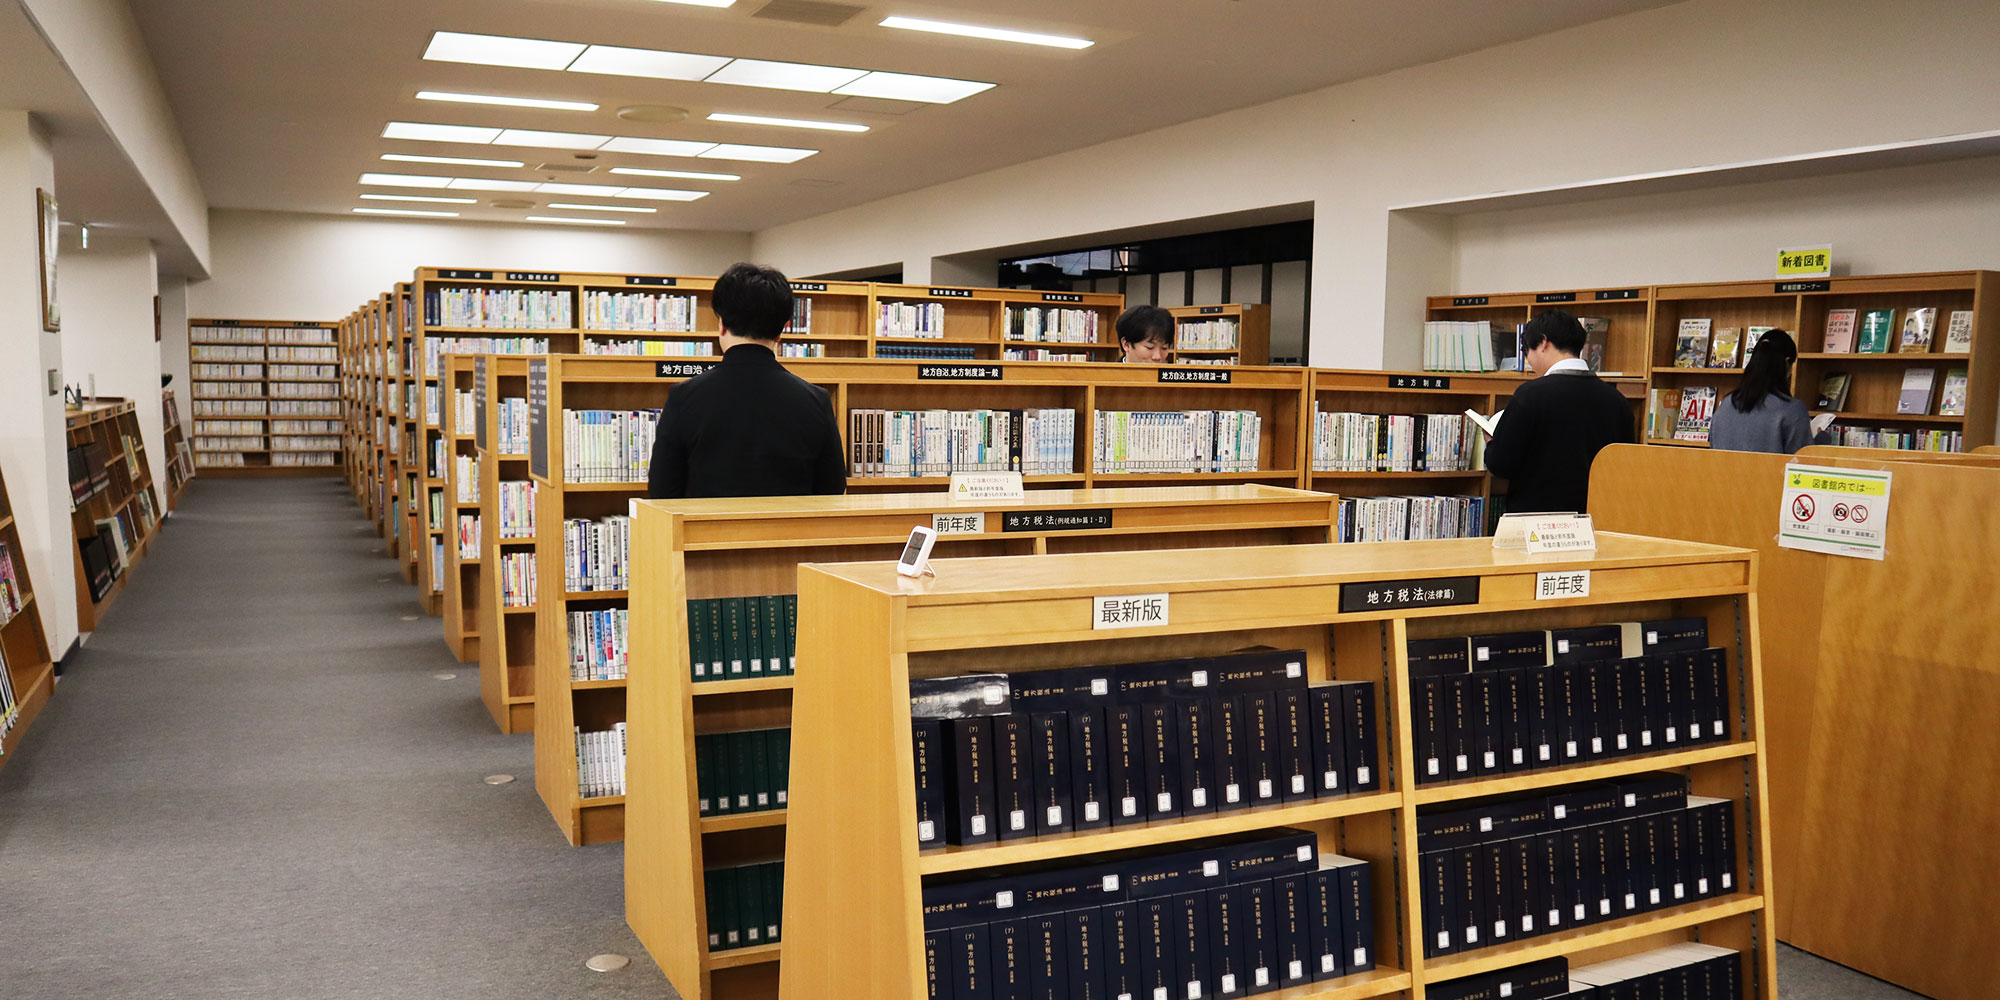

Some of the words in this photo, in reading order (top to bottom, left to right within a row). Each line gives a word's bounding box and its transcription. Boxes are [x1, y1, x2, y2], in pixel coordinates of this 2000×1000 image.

[1781, 253, 1825, 268] 新着図書
[1685, 399, 1707, 420] AI
[937, 516, 977, 532] 前年度
[1367, 587, 1455, 604] 地方税法(法律篇)
[1543, 575, 1586, 597] 前年度
[1102, 599, 1161, 623] 最新版
